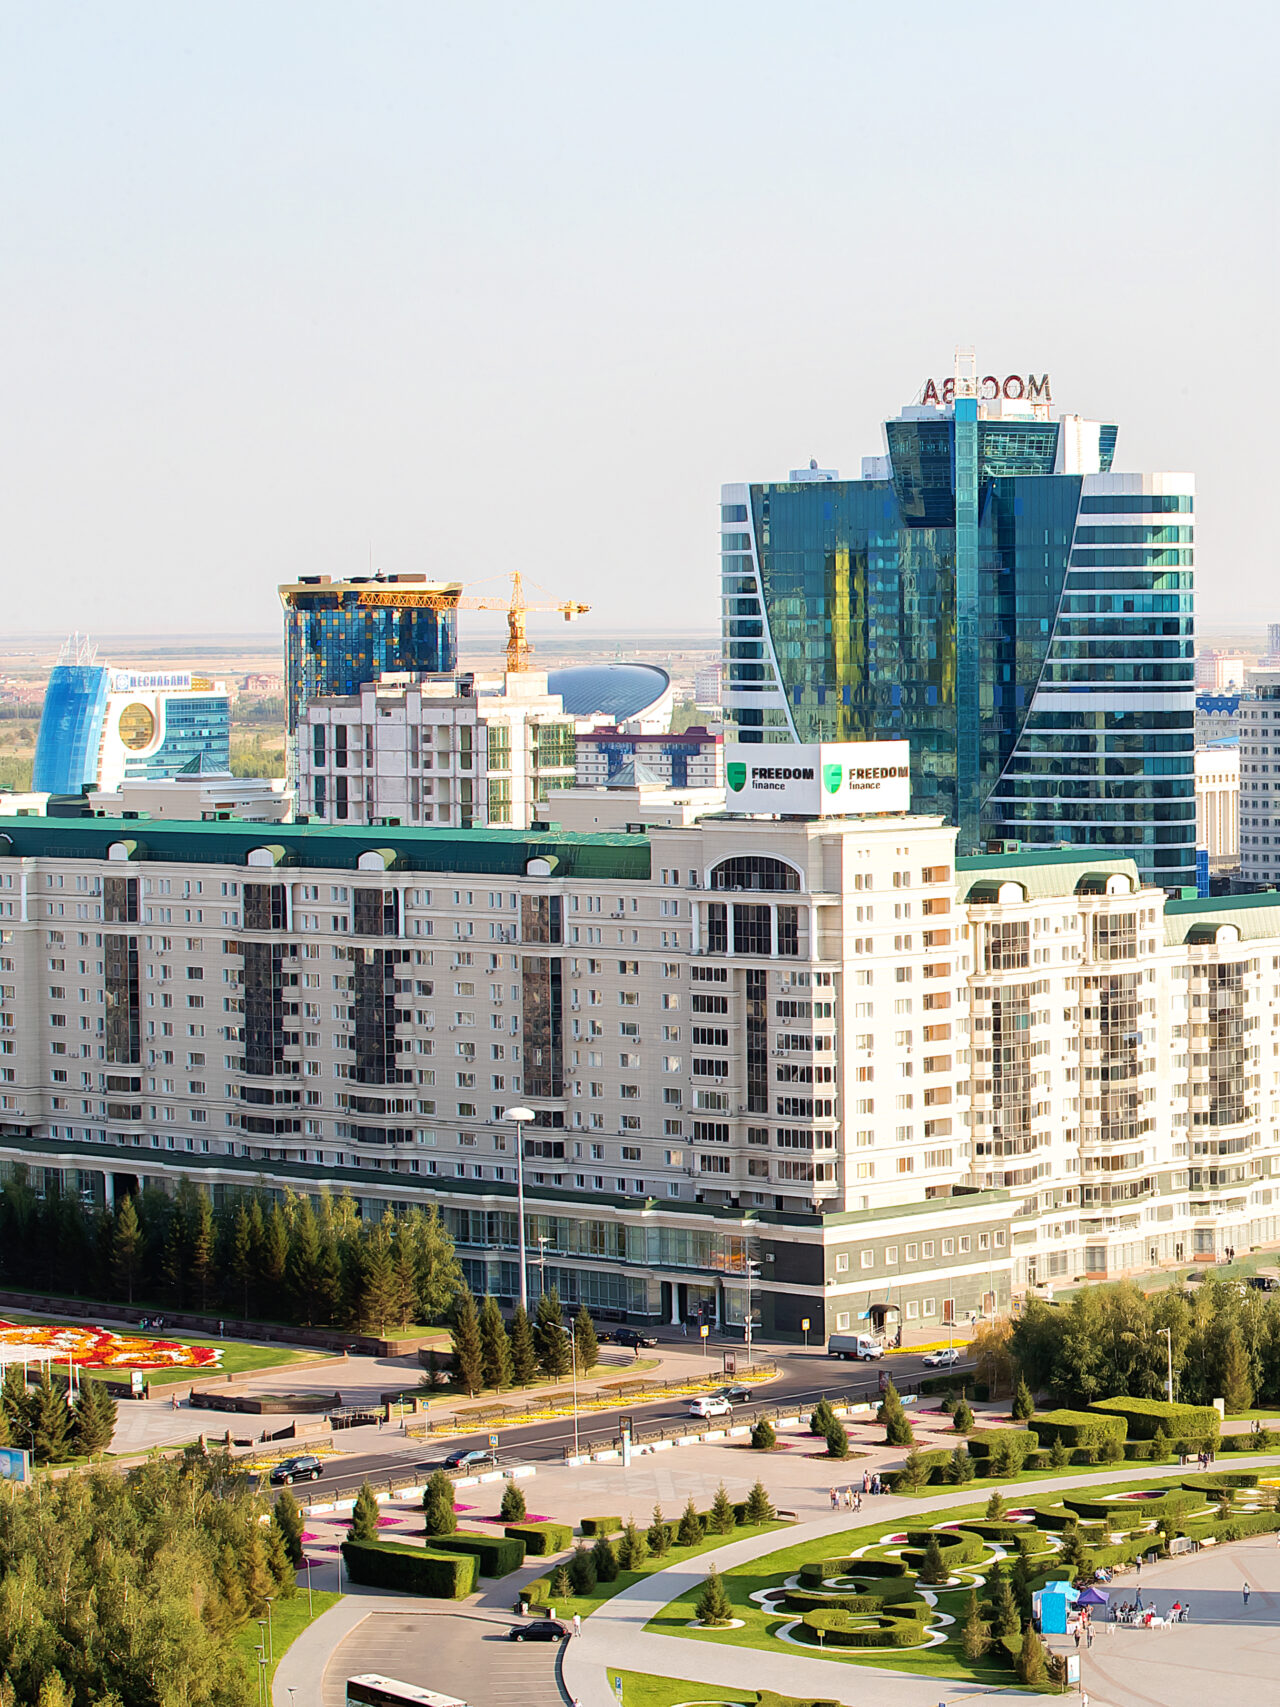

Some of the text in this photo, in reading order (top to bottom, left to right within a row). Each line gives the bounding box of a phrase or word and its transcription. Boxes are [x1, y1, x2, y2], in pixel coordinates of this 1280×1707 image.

[751, 767, 814, 780] FREEDOM
[849, 765, 909, 779] FREEDOM
[751, 780, 786, 791] finance
[849, 780, 880, 791] finance
